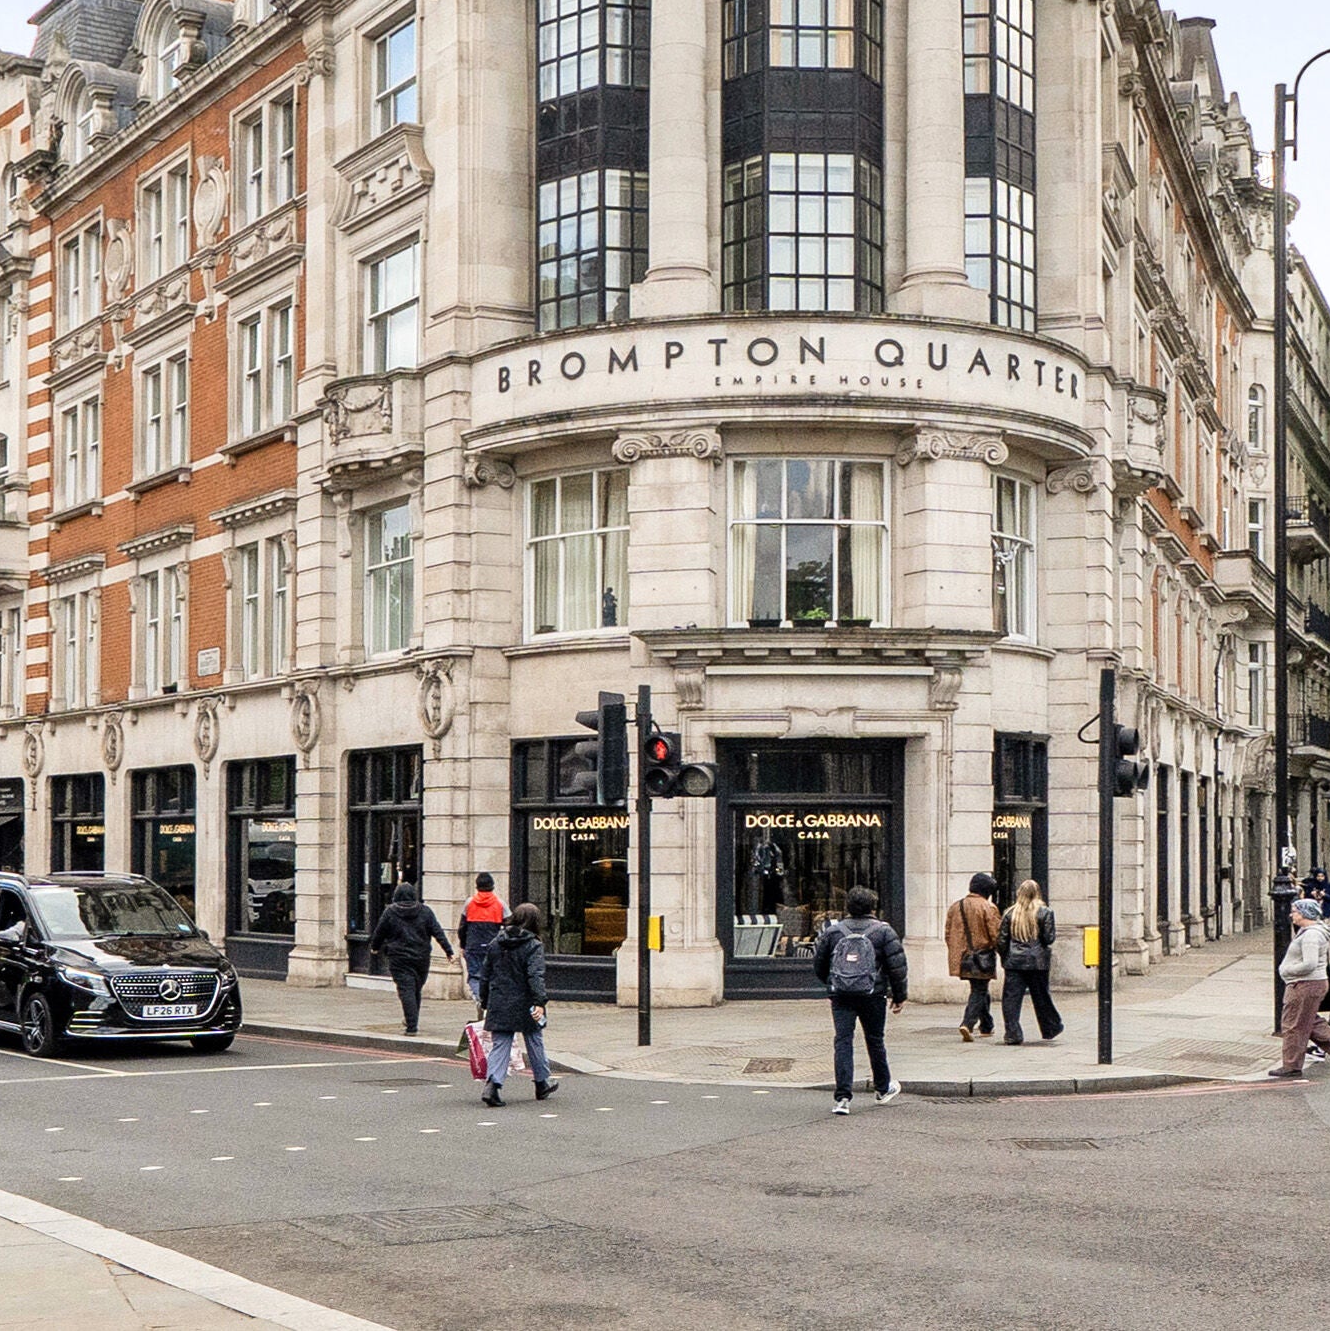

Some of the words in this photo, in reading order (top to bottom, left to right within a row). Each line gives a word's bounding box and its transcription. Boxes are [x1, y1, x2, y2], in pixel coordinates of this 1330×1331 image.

[497, 336, 826, 394] BROMPTON
[874, 338, 1079, 400] QUARTER
[715, 374, 817, 387] EMPIRE
[839, 374, 924, 389] HOUSE
[571, 833, 596, 841] CASA
[797, 831, 830, 839] CASA
[993, 831, 1009, 839] CASA
